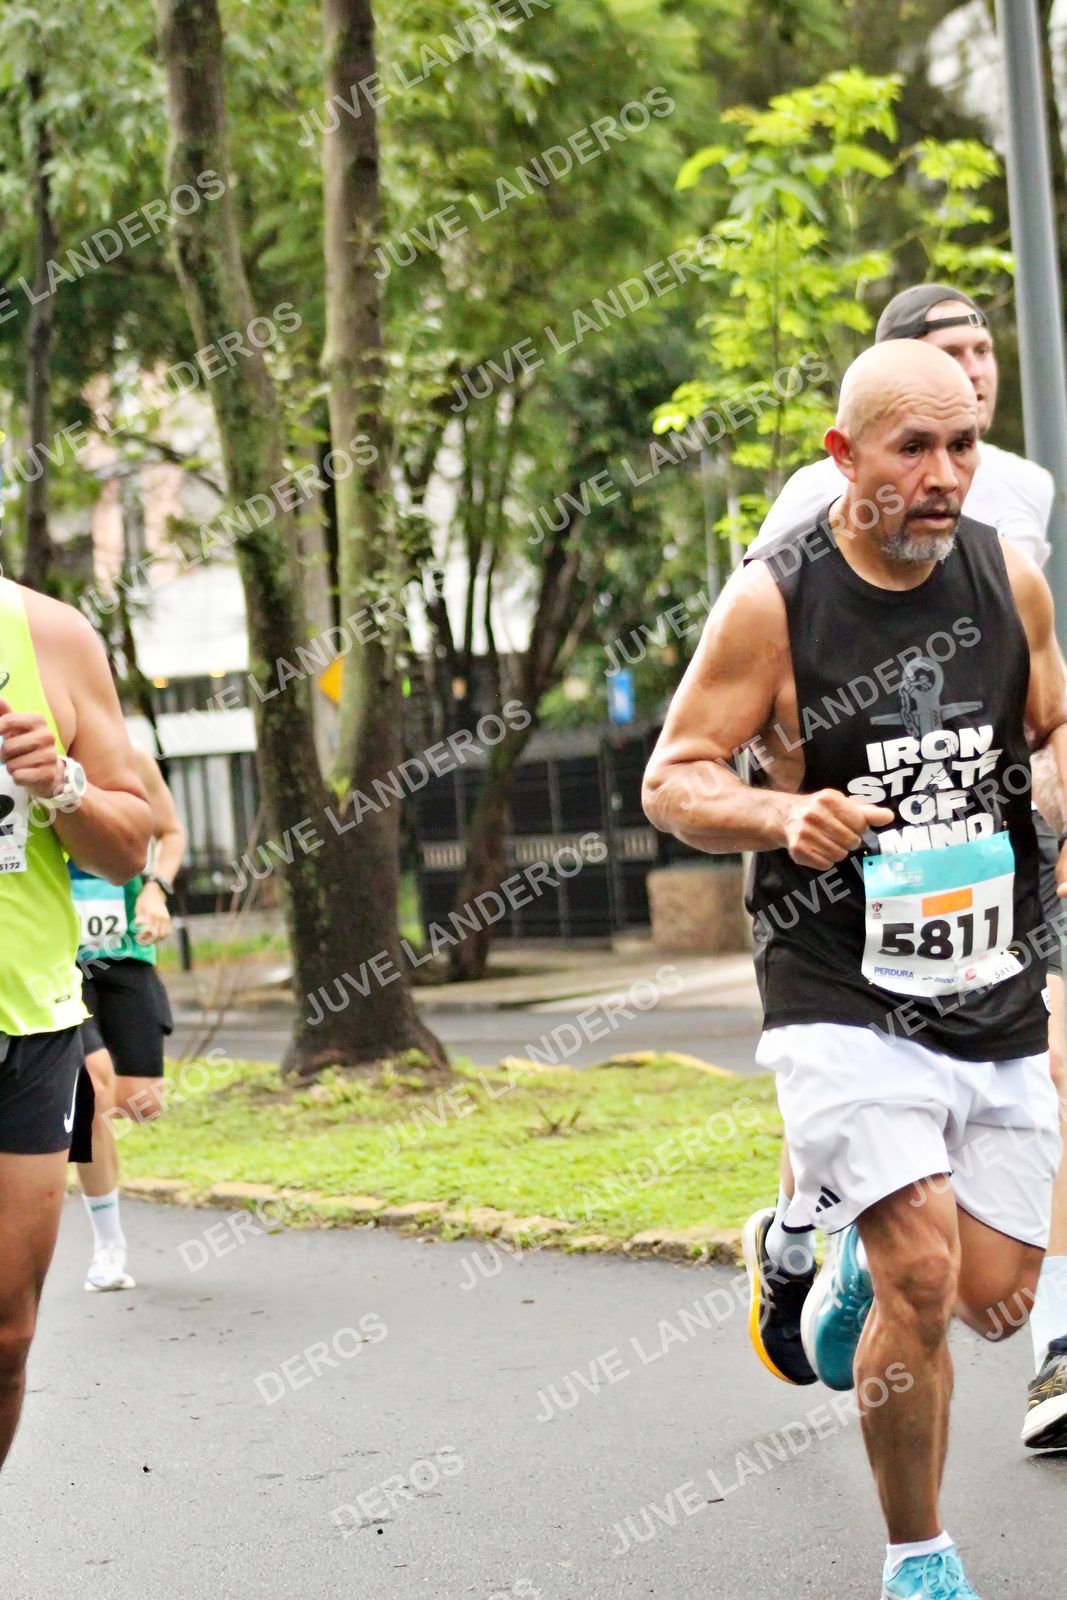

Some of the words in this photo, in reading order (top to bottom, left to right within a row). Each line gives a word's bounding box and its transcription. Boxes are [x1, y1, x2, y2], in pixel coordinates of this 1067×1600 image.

[865, 725, 994, 772] IRON
[847, 749, 1003, 804] STATE
[898, 790, 969, 824] OF
[878, 906, 999, 960] 5811
[874, 966, 914, 978] PERDURA
